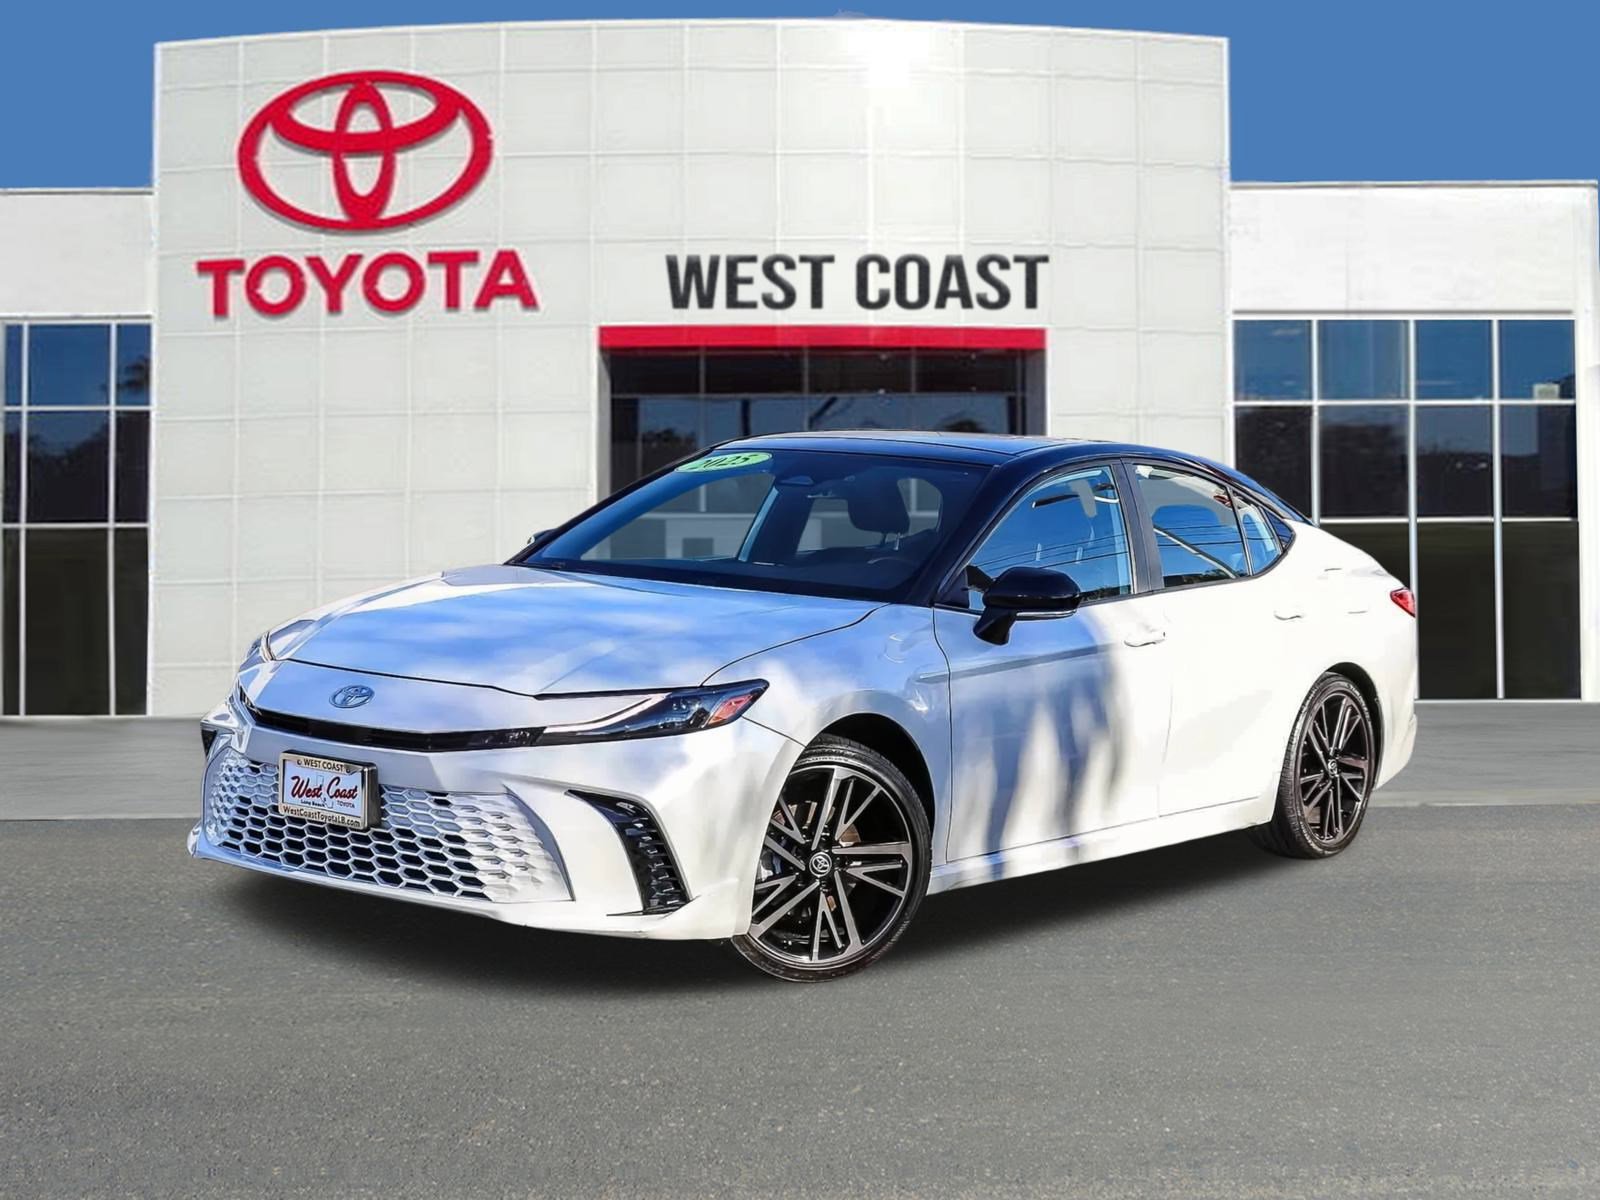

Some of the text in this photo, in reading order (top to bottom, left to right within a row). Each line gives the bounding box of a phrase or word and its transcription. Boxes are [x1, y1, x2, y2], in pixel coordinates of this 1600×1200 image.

[196, 250, 539, 317] TOYOTA
[665, 254, 1050, 310] WEST COAST
[303, 758, 343, 772] WEST COAST
[290, 775, 358, 800] West Coast
[337, 800, 355, 808] TOYOTA
[283, 805, 361, 827] WestCoastToyotaLB.com
